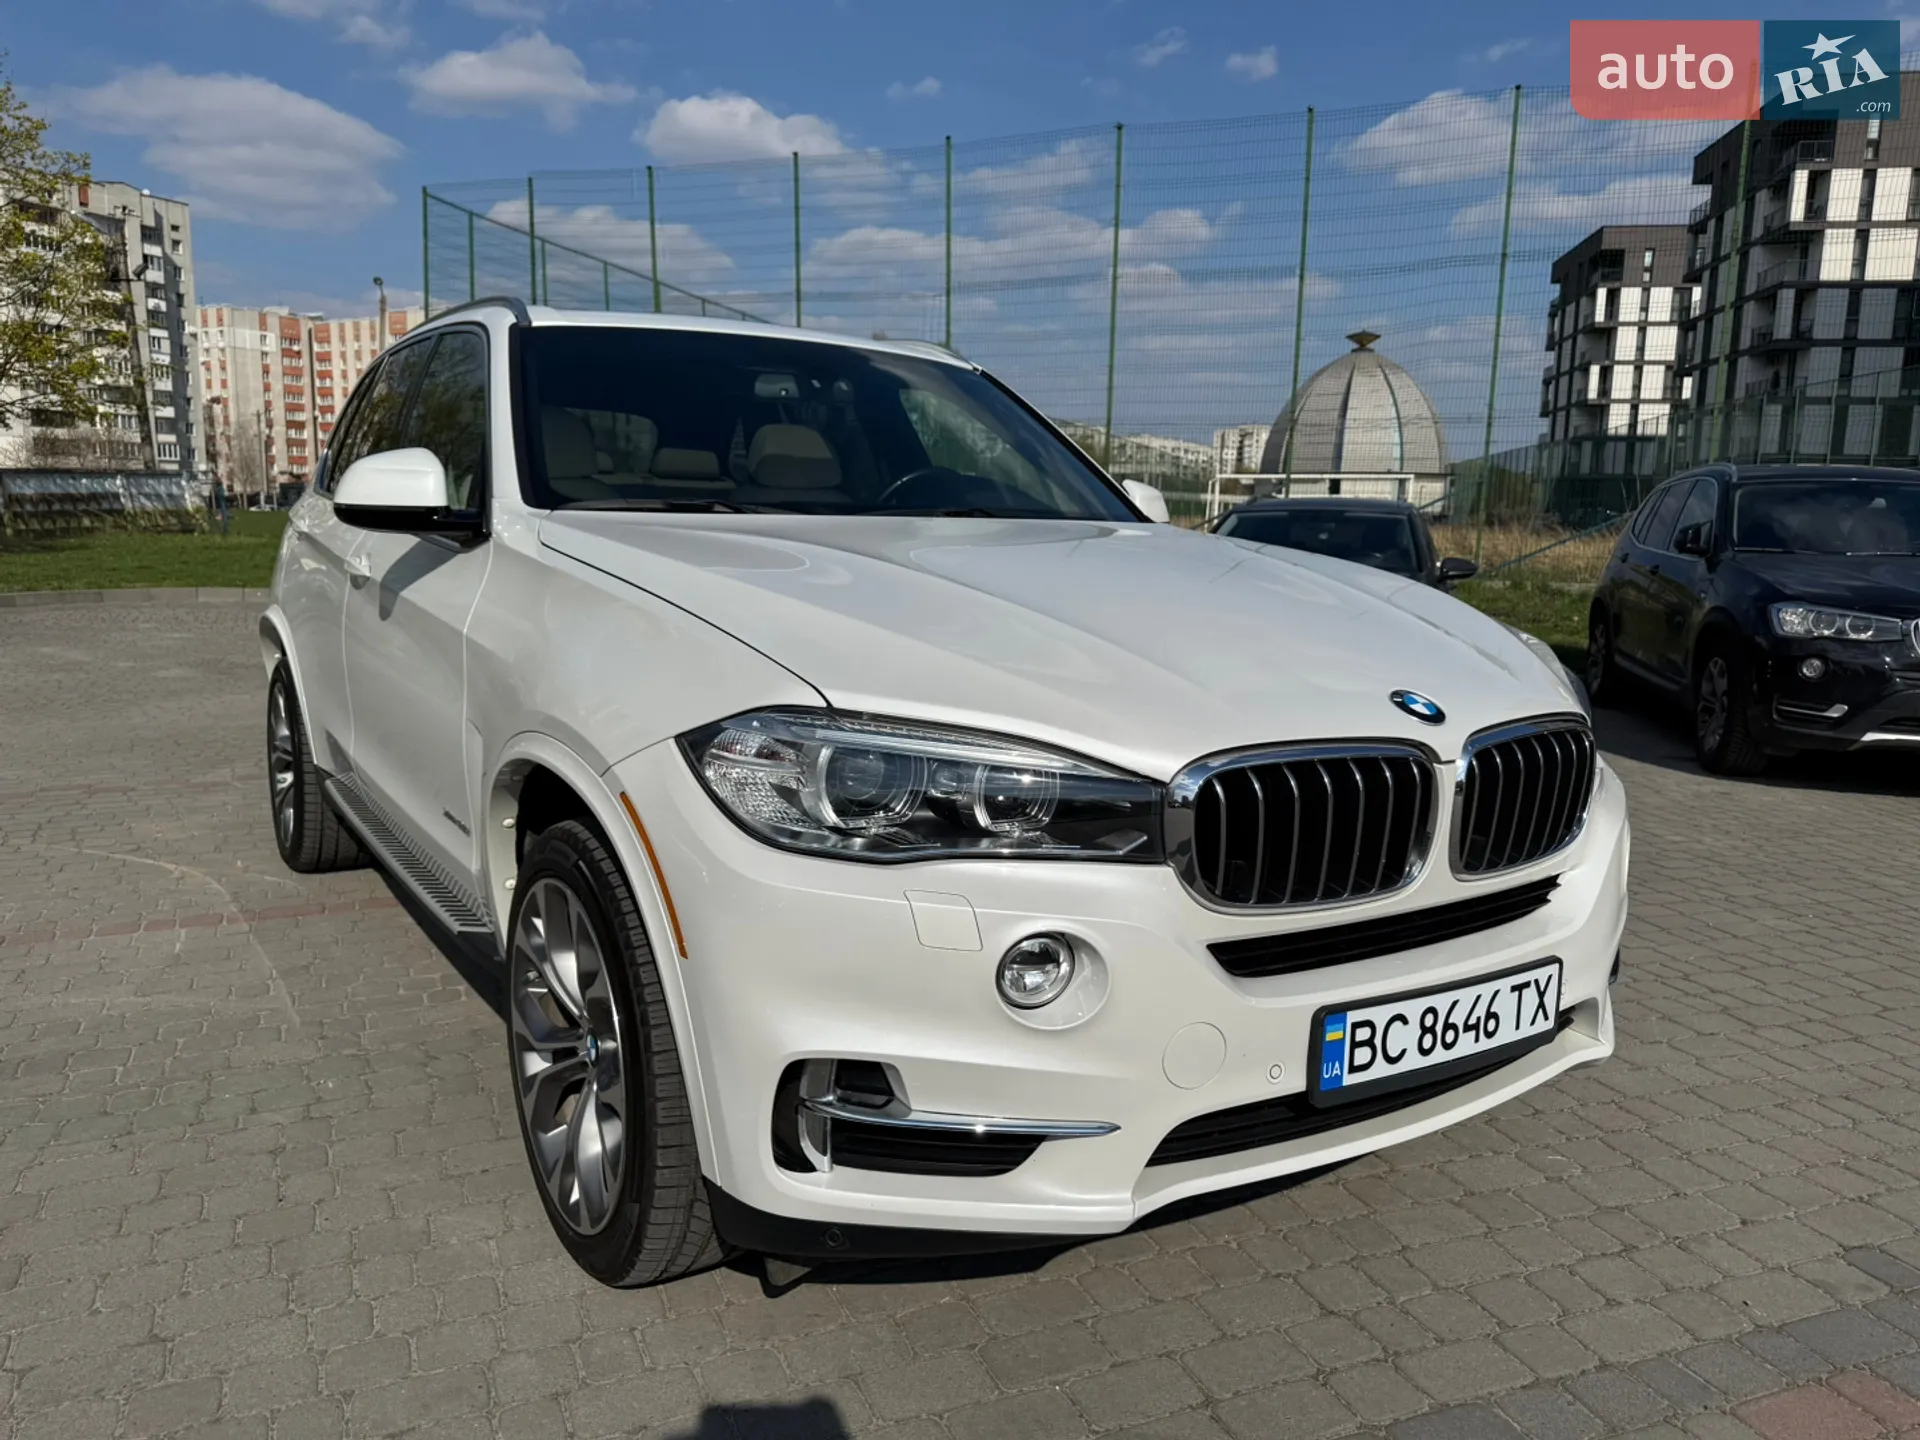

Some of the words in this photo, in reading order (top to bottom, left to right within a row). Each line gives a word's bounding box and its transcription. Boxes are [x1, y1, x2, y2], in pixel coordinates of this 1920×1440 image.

[1348, 1014, 1409, 1075] BC
[1417, 989, 1501, 1057] 8646
[1510, 974, 1553, 1031] TX
[1322, 1062, 1341, 1079] UA
